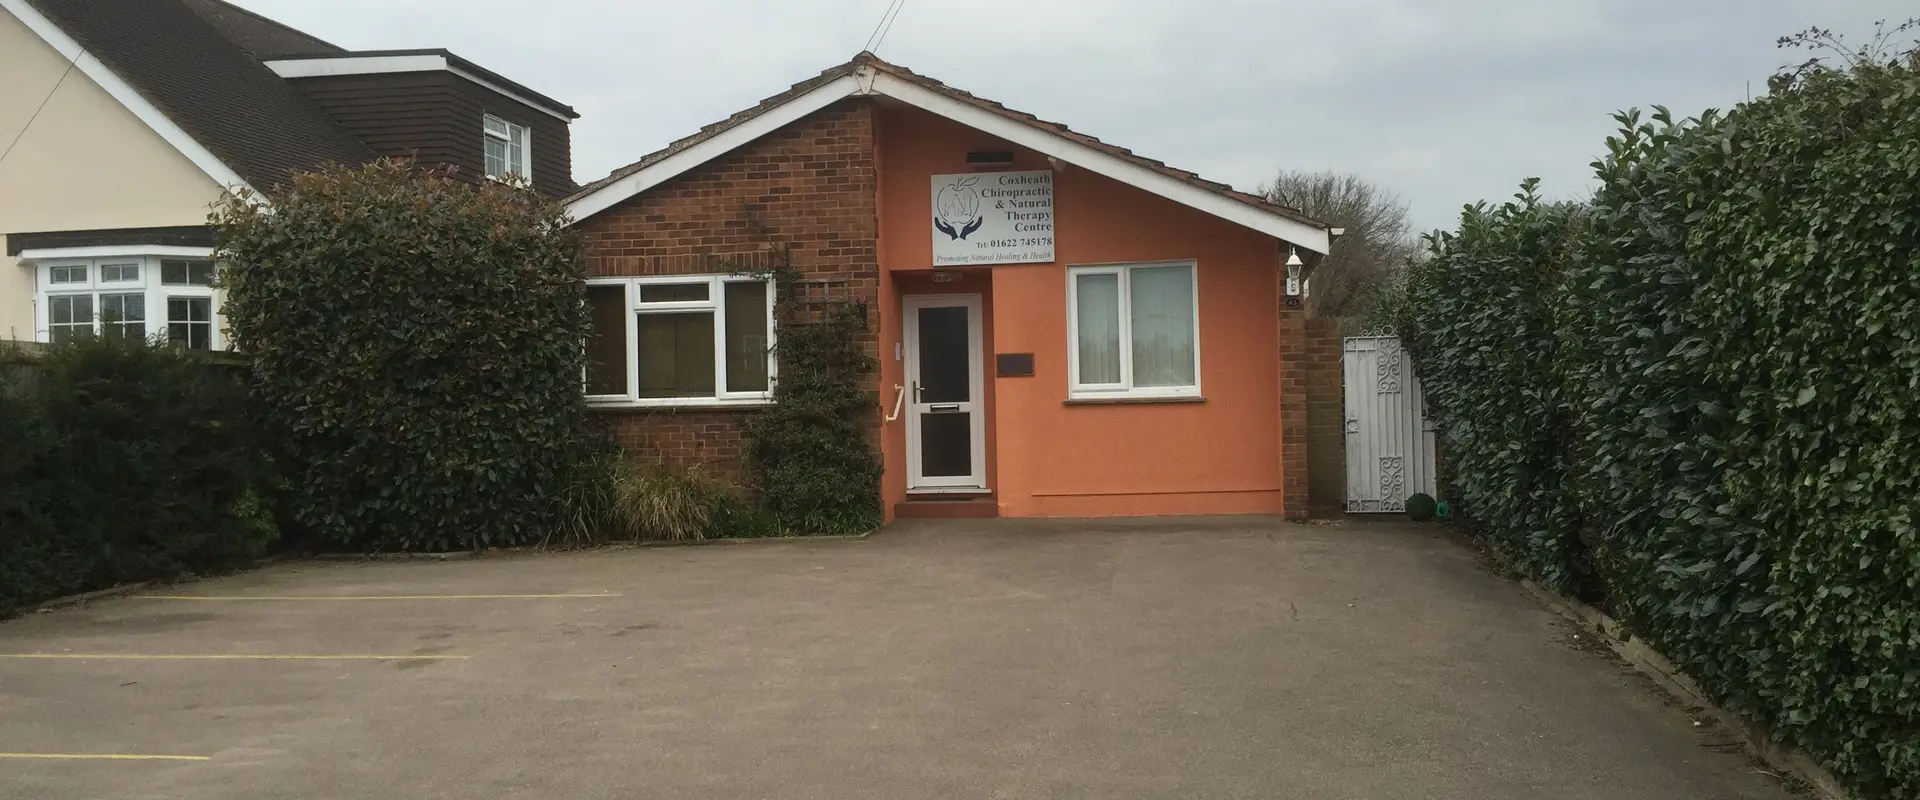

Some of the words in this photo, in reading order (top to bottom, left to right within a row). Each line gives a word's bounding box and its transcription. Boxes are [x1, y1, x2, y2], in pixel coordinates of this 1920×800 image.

[999, 174, 1050, 185] Coxheath
[982, 186, 1051, 198] Chiropractic
[995, 200, 1004, 209] &
[1009, 198, 1051, 208] Natural
[1005, 212, 1052, 222] Therapy
[1014, 223, 1052, 232] Centre
[990, 240, 1017, 248] 01622
[1020, 238, 1052, 246] 745178
[936, 254, 968, 262] Promoting
[995, 252, 1020, 261] Healing
[1030, 252, 1052, 260] Health
